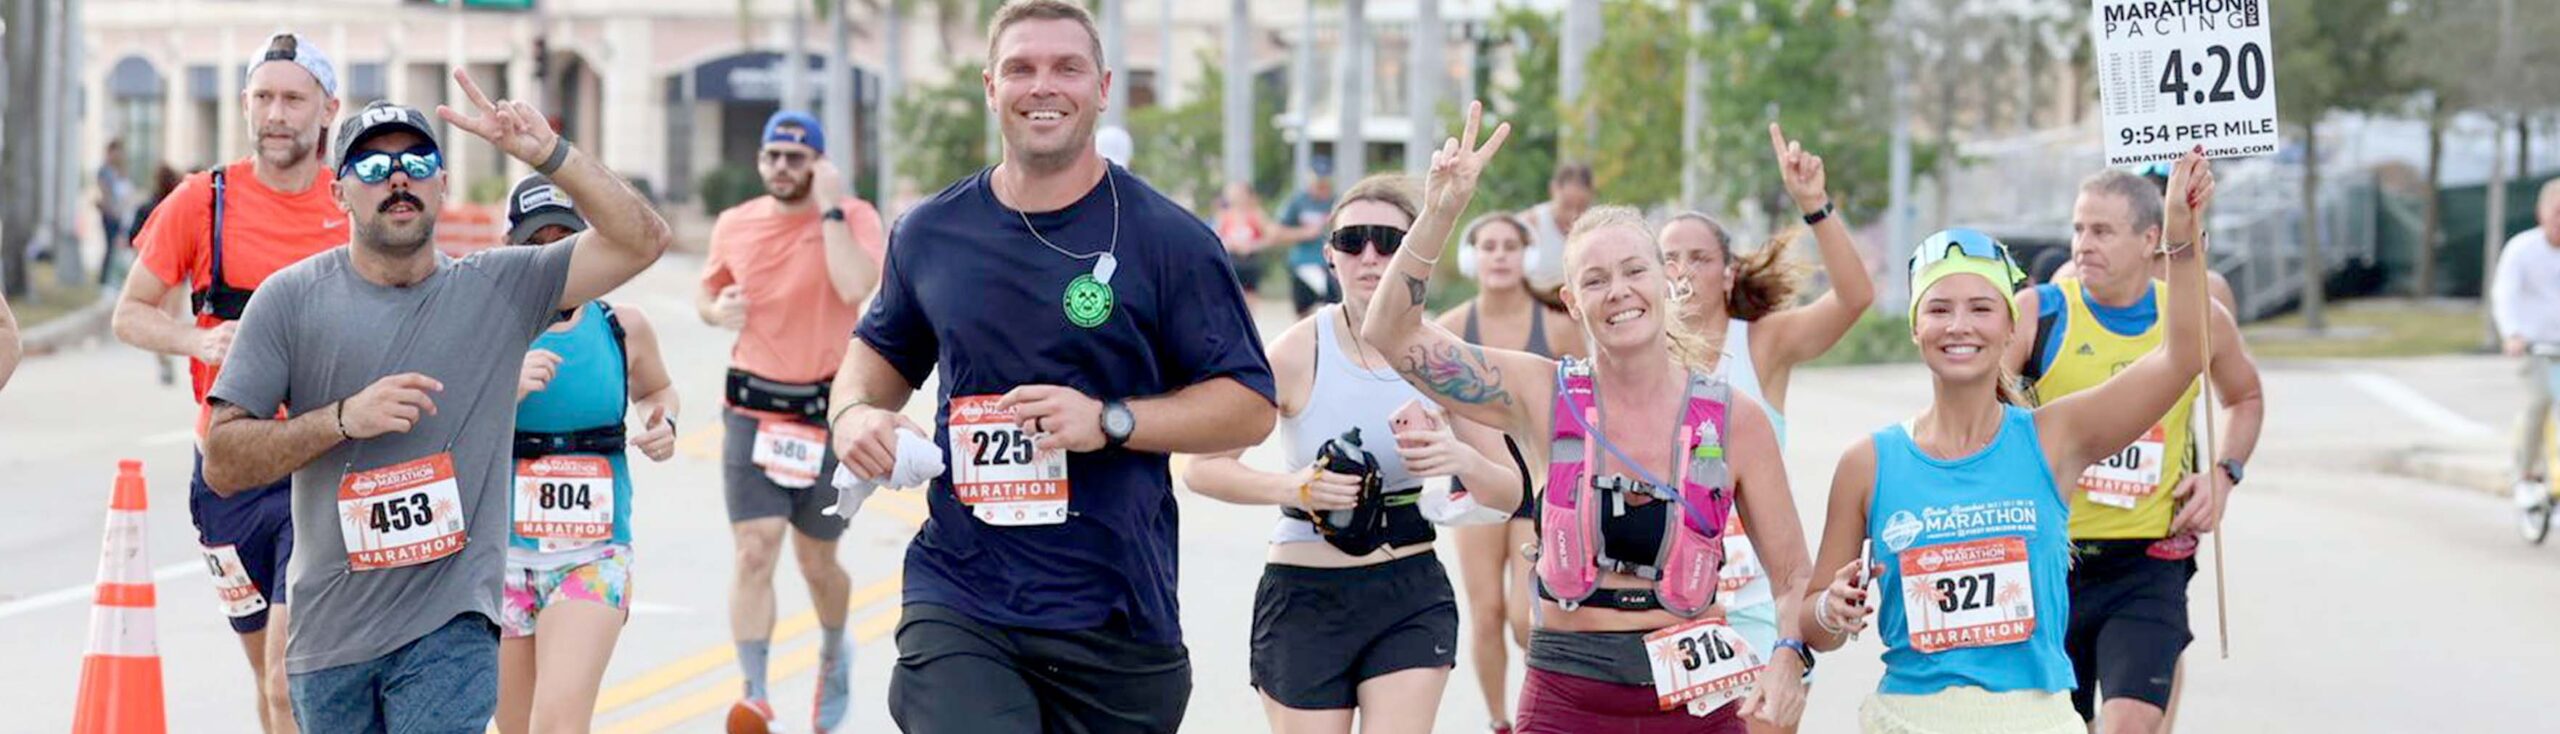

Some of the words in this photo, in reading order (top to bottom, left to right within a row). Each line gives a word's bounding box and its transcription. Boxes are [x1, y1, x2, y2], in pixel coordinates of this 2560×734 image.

[2104, 0, 2243, 22] MARATHON
[2105, 11, 2244, 40] PACING
[2159, 42, 2266, 106] 4:20
[2120, 125, 2170, 146] 9:54
[2176, 123, 2218, 140] PER
[2224, 118, 2275, 137] MILE
[971, 430, 1034, 467] 225
[540, 483, 592, 510] 804
[959, 482, 1057, 498] MARATHON
[369, 491, 434, 534] 453
[1925, 507, 2037, 533] MARATHON
[522, 522, 607, 535] MARATHON
[358, 536, 458, 564] MARATHON
[1936, 572, 1996, 614] 327
[1919, 621, 2025, 647] MARATHON
